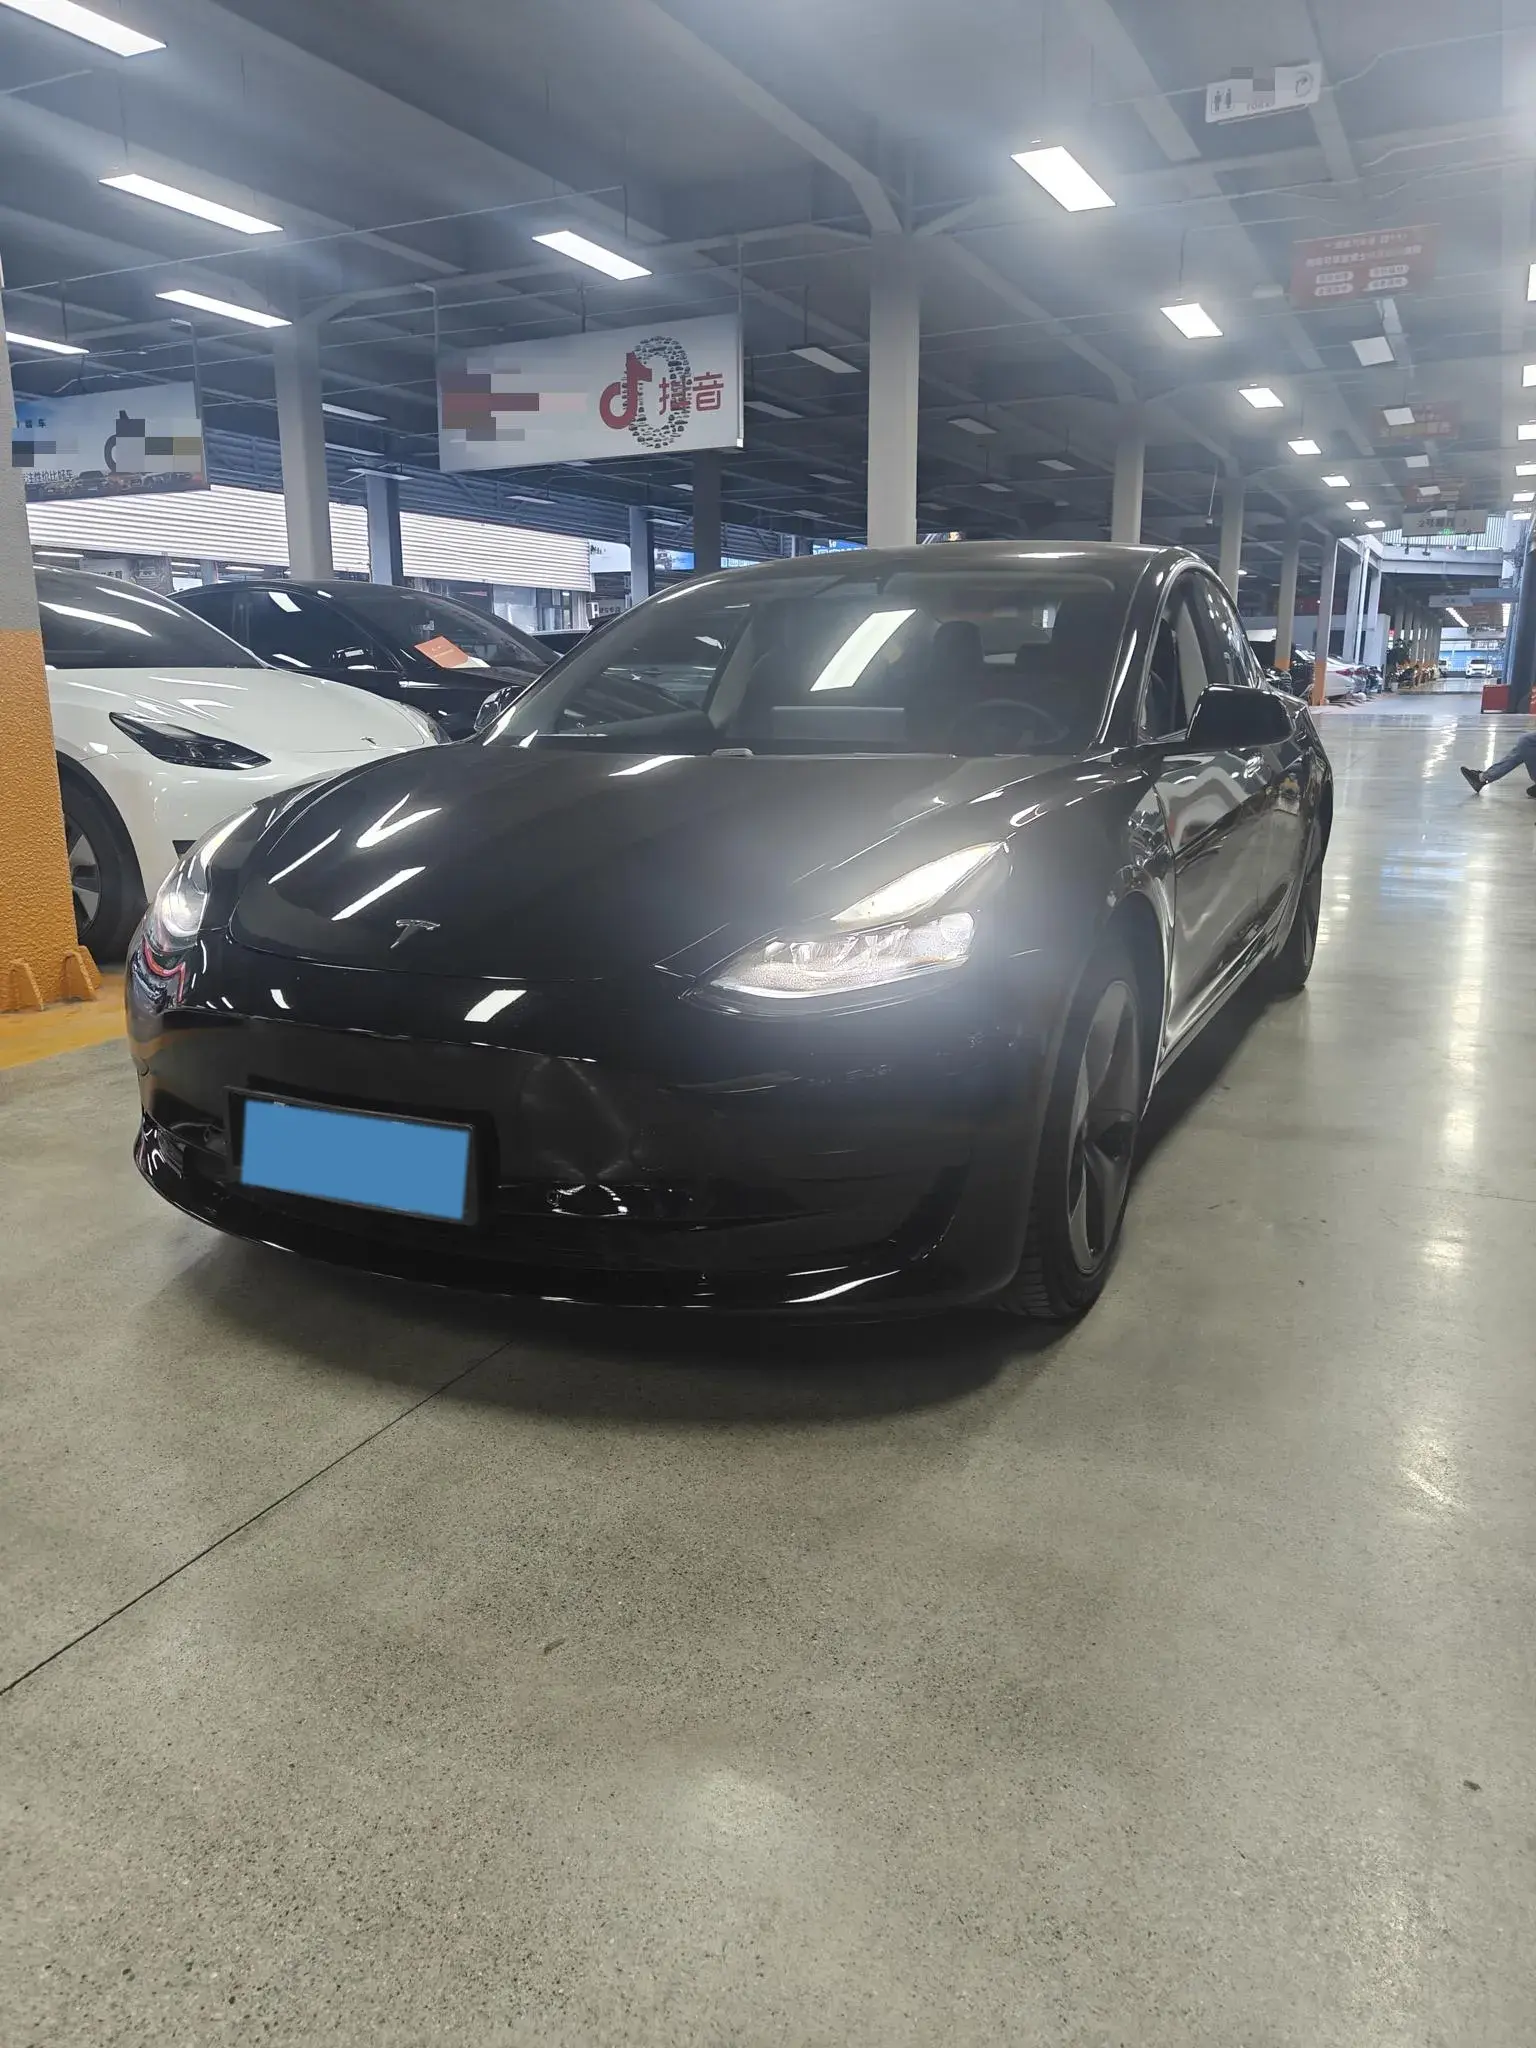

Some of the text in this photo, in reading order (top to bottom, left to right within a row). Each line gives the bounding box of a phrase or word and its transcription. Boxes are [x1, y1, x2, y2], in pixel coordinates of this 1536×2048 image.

[659, 371, 724, 415] 抖音
[24, 470, 73, 483] 注性价比好车
